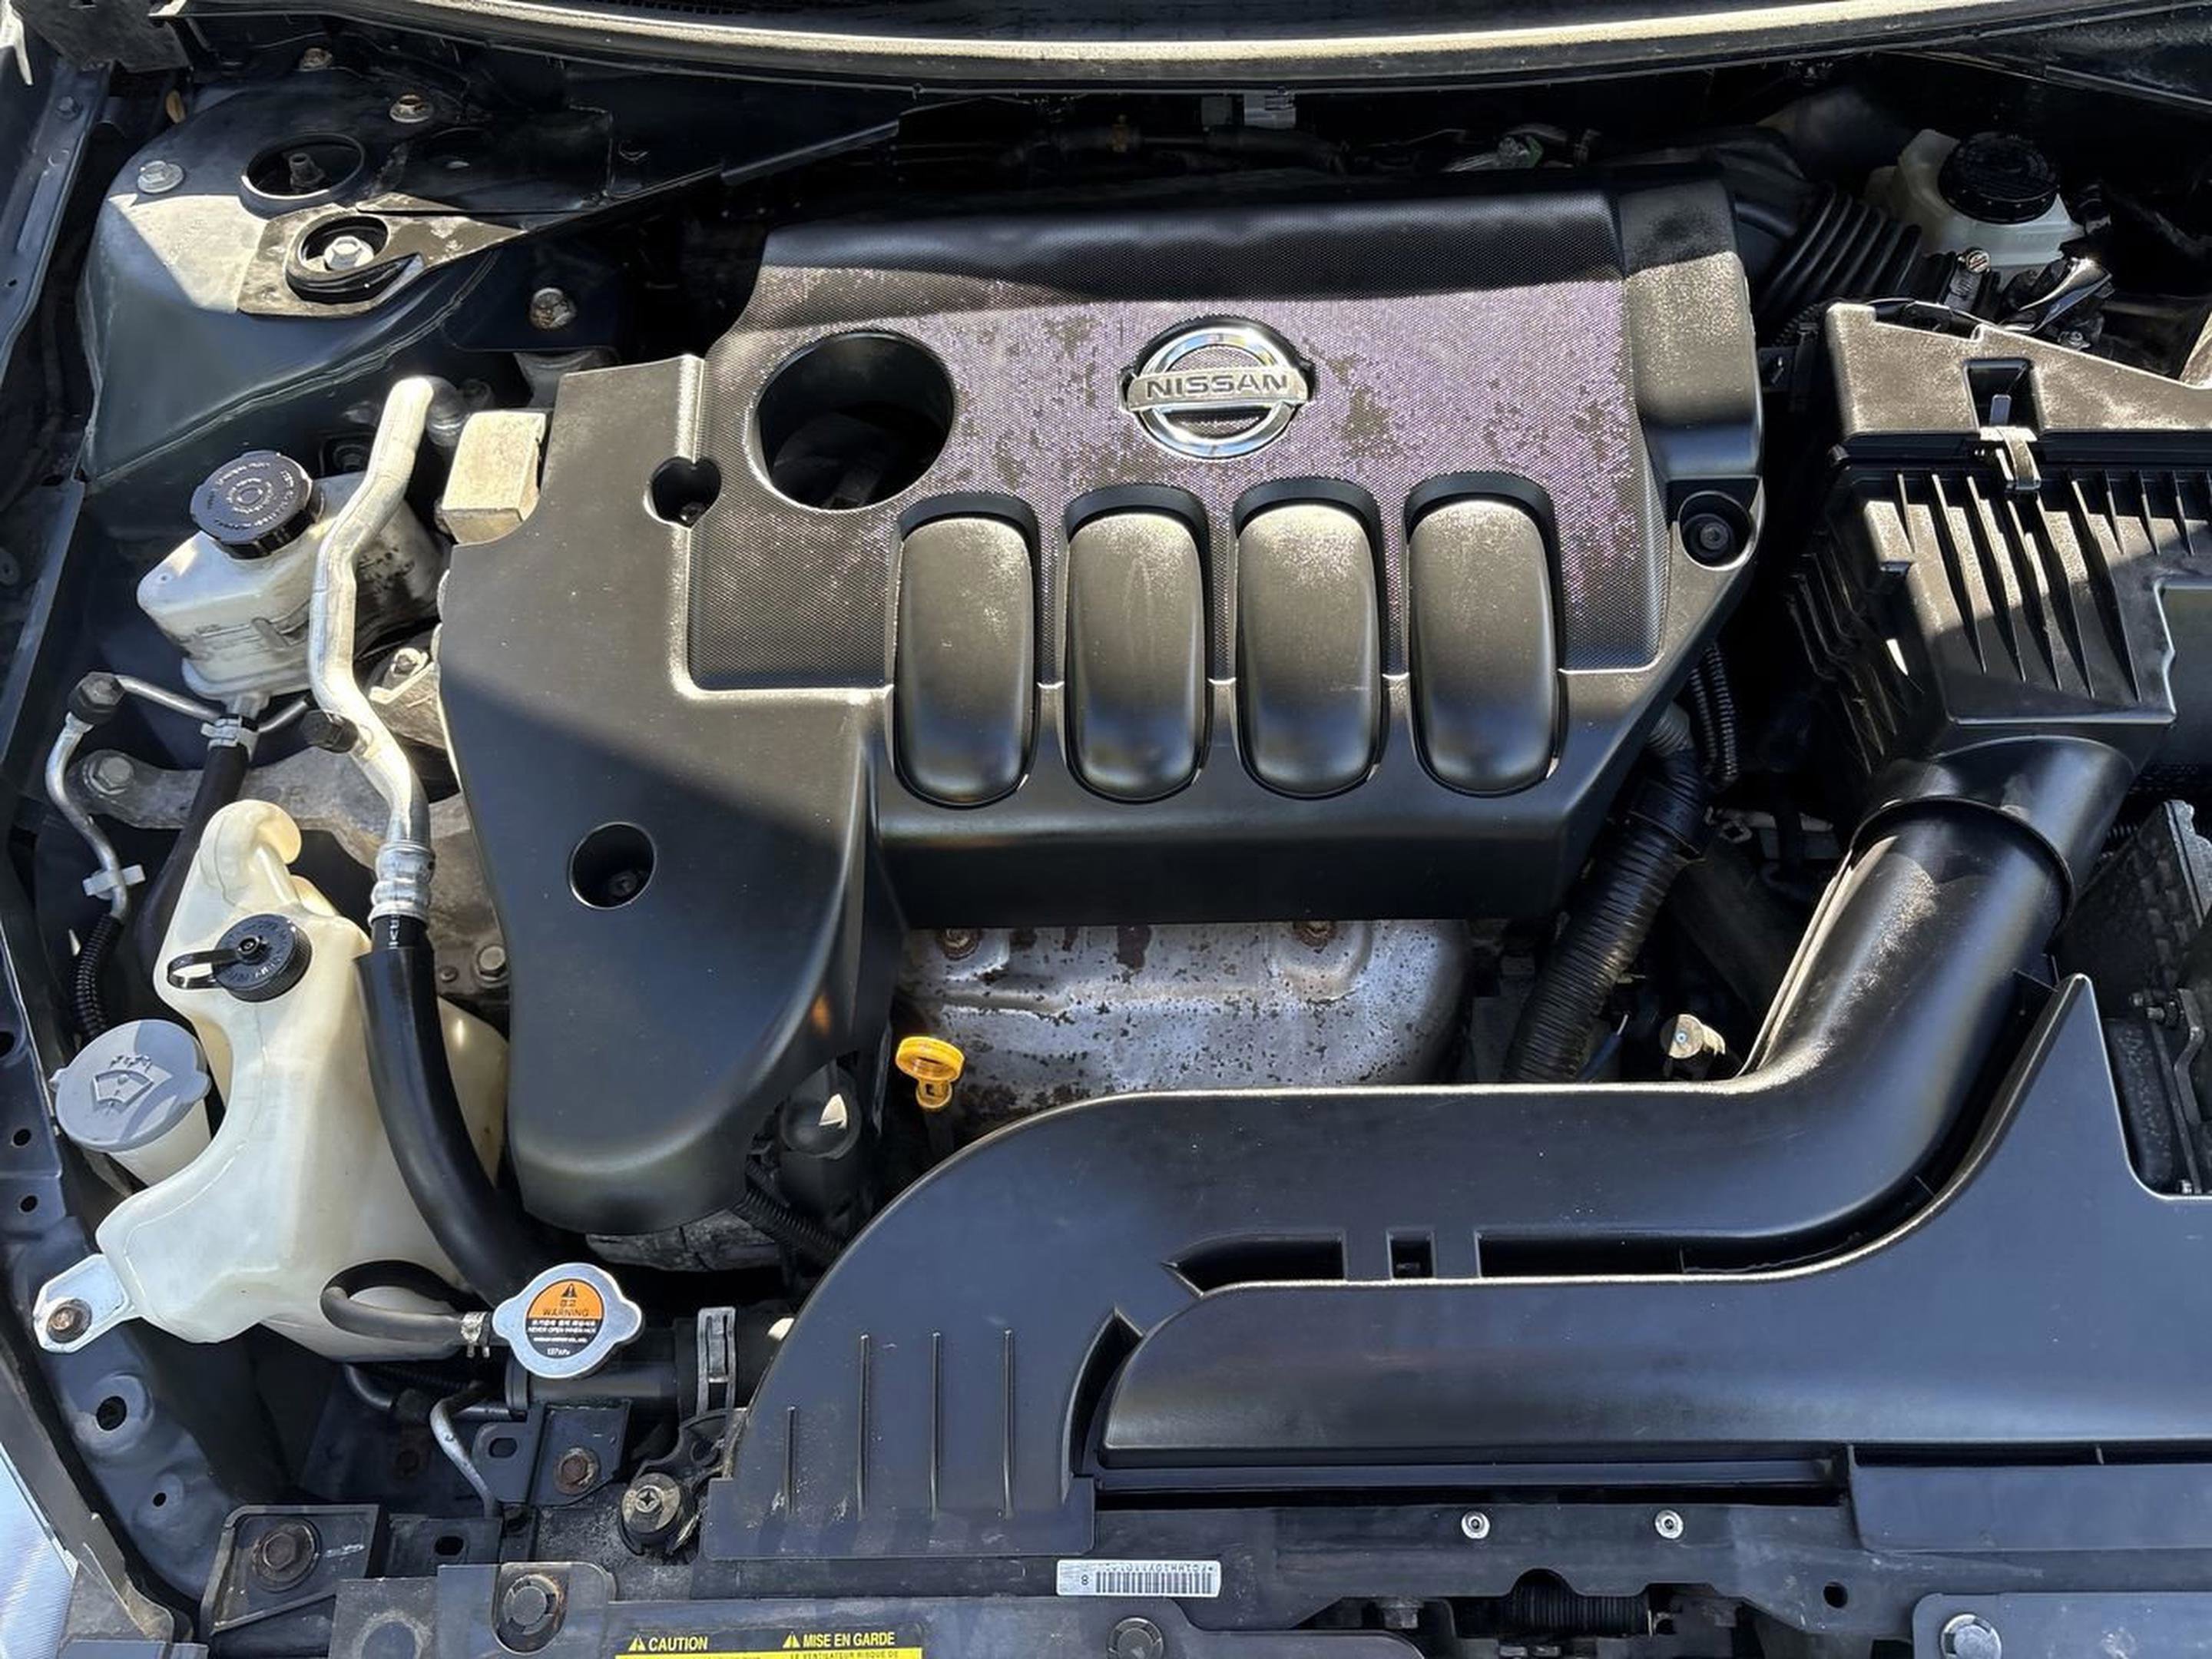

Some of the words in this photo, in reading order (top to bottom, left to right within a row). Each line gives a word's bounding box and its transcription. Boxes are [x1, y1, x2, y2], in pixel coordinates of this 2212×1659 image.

[1147, 374, 1288, 399] NISSAN
[542, 1308, 590, 1316] WARNING
[648, 1637, 708, 1651] CAUTION
[803, 1634, 831, 1647] MISE
[834, 1634, 851, 1647] EN
[853, 1632, 896, 1646] GARDE
